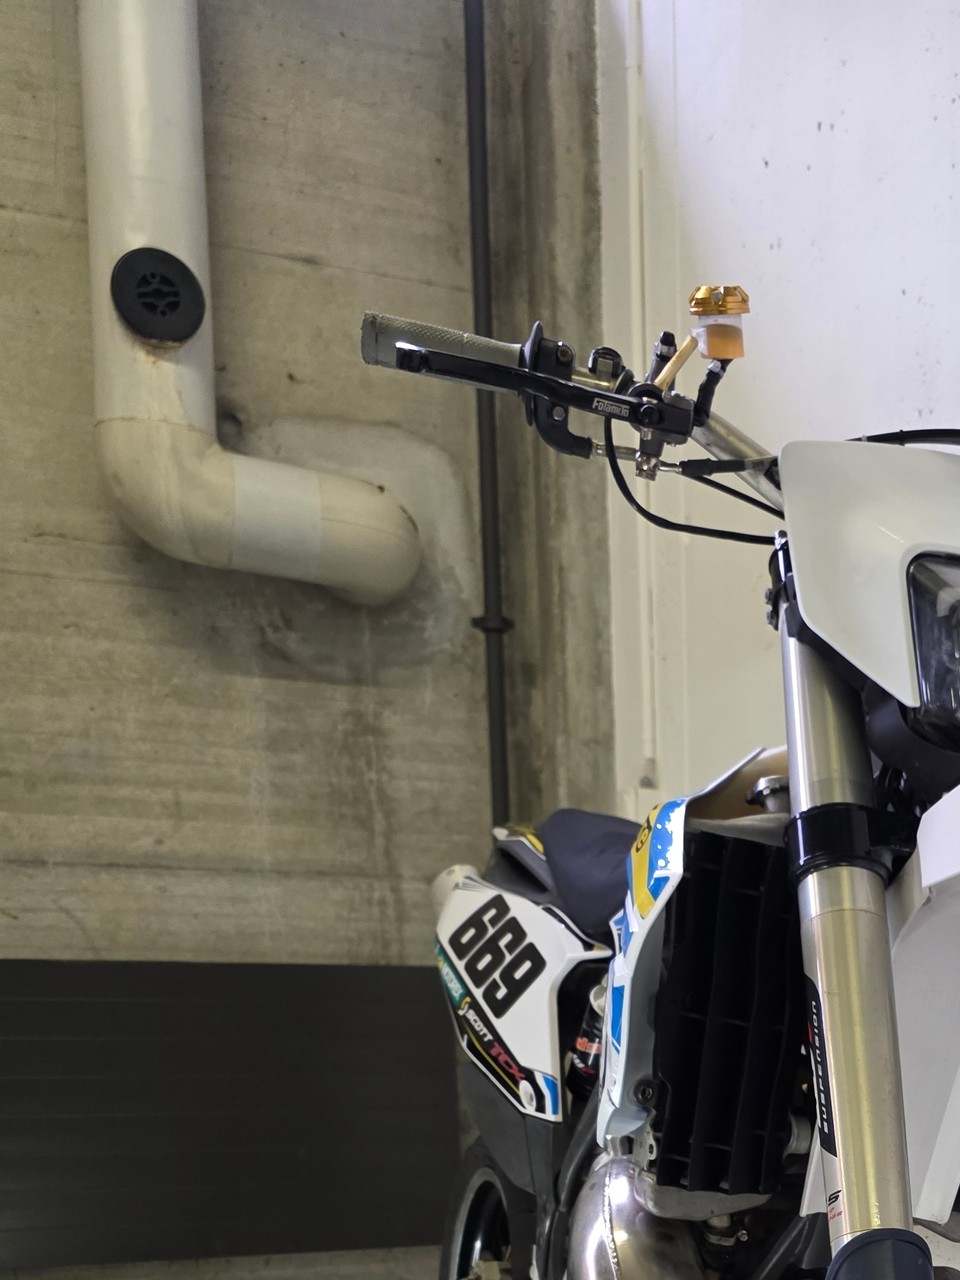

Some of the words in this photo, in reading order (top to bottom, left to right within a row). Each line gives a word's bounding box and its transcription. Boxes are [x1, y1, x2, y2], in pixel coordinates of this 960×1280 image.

[449, 893, 547, 1019] 669
[465, 1007, 494, 1043] SCOTT
[489, 1038, 527, 1082] TCX
